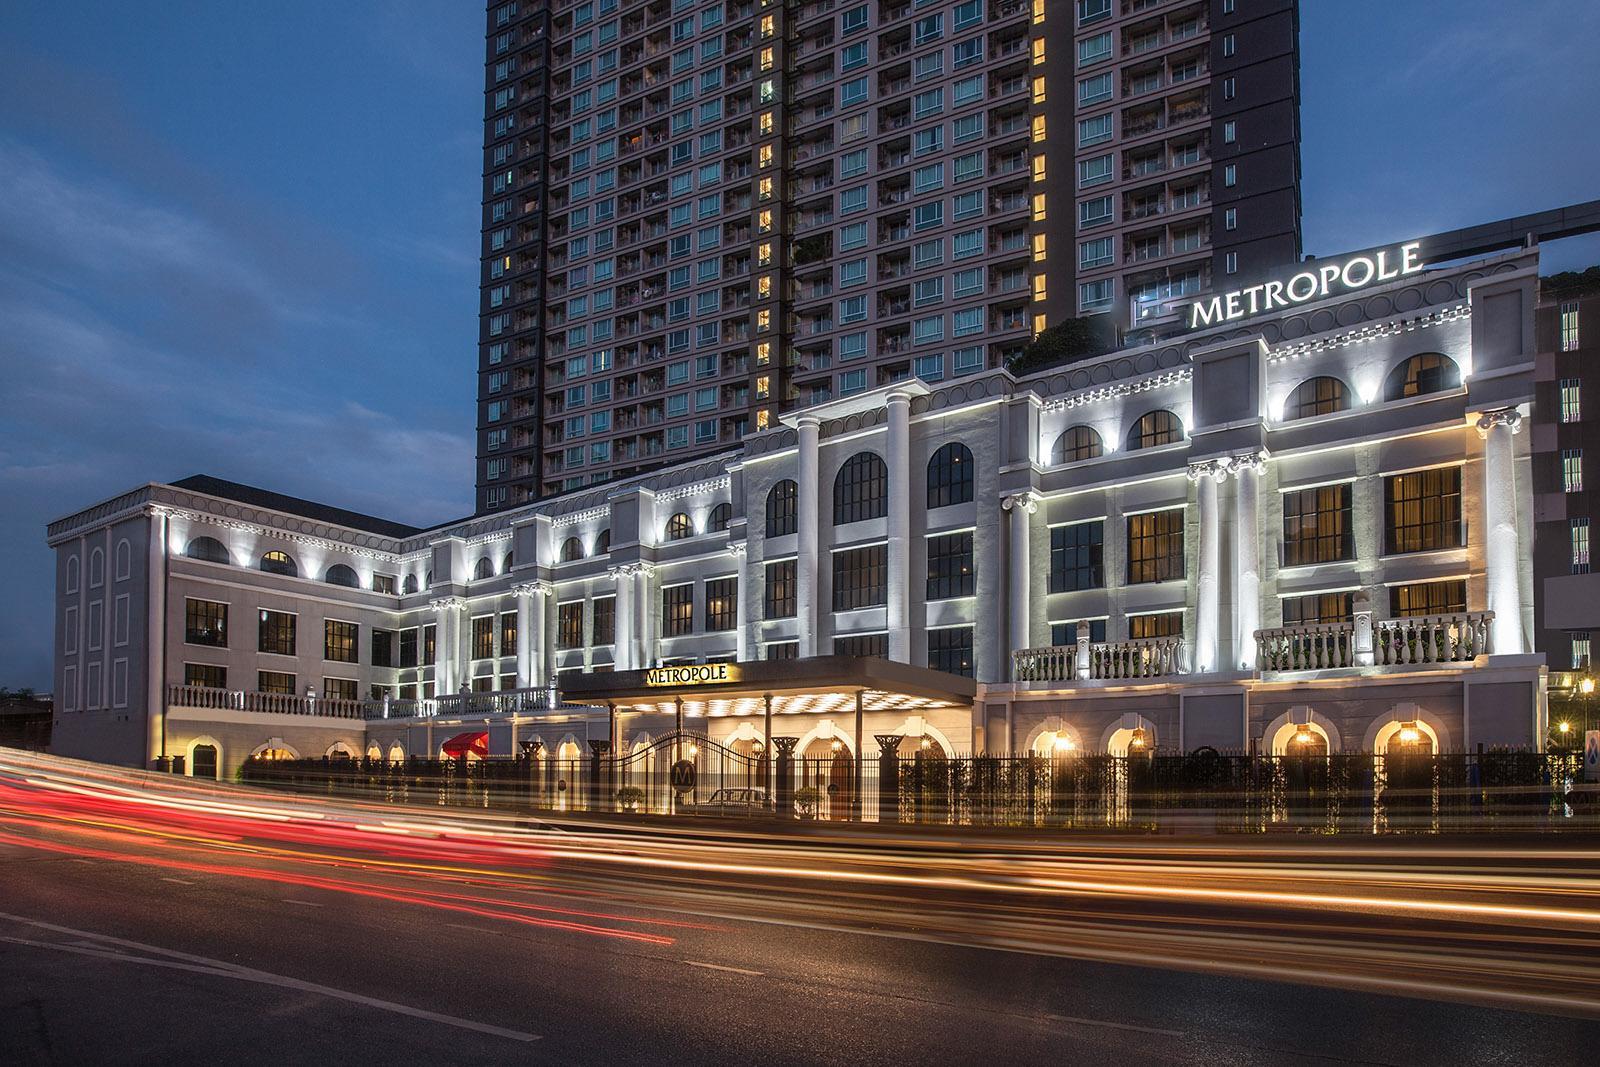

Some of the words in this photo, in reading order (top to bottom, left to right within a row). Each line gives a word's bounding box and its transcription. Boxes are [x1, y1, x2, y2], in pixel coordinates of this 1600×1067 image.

[1191, 243, 1424, 328] METROPOLE
[646, 666, 727, 683] METROPOLE
[674, 767, 691, 784] M
